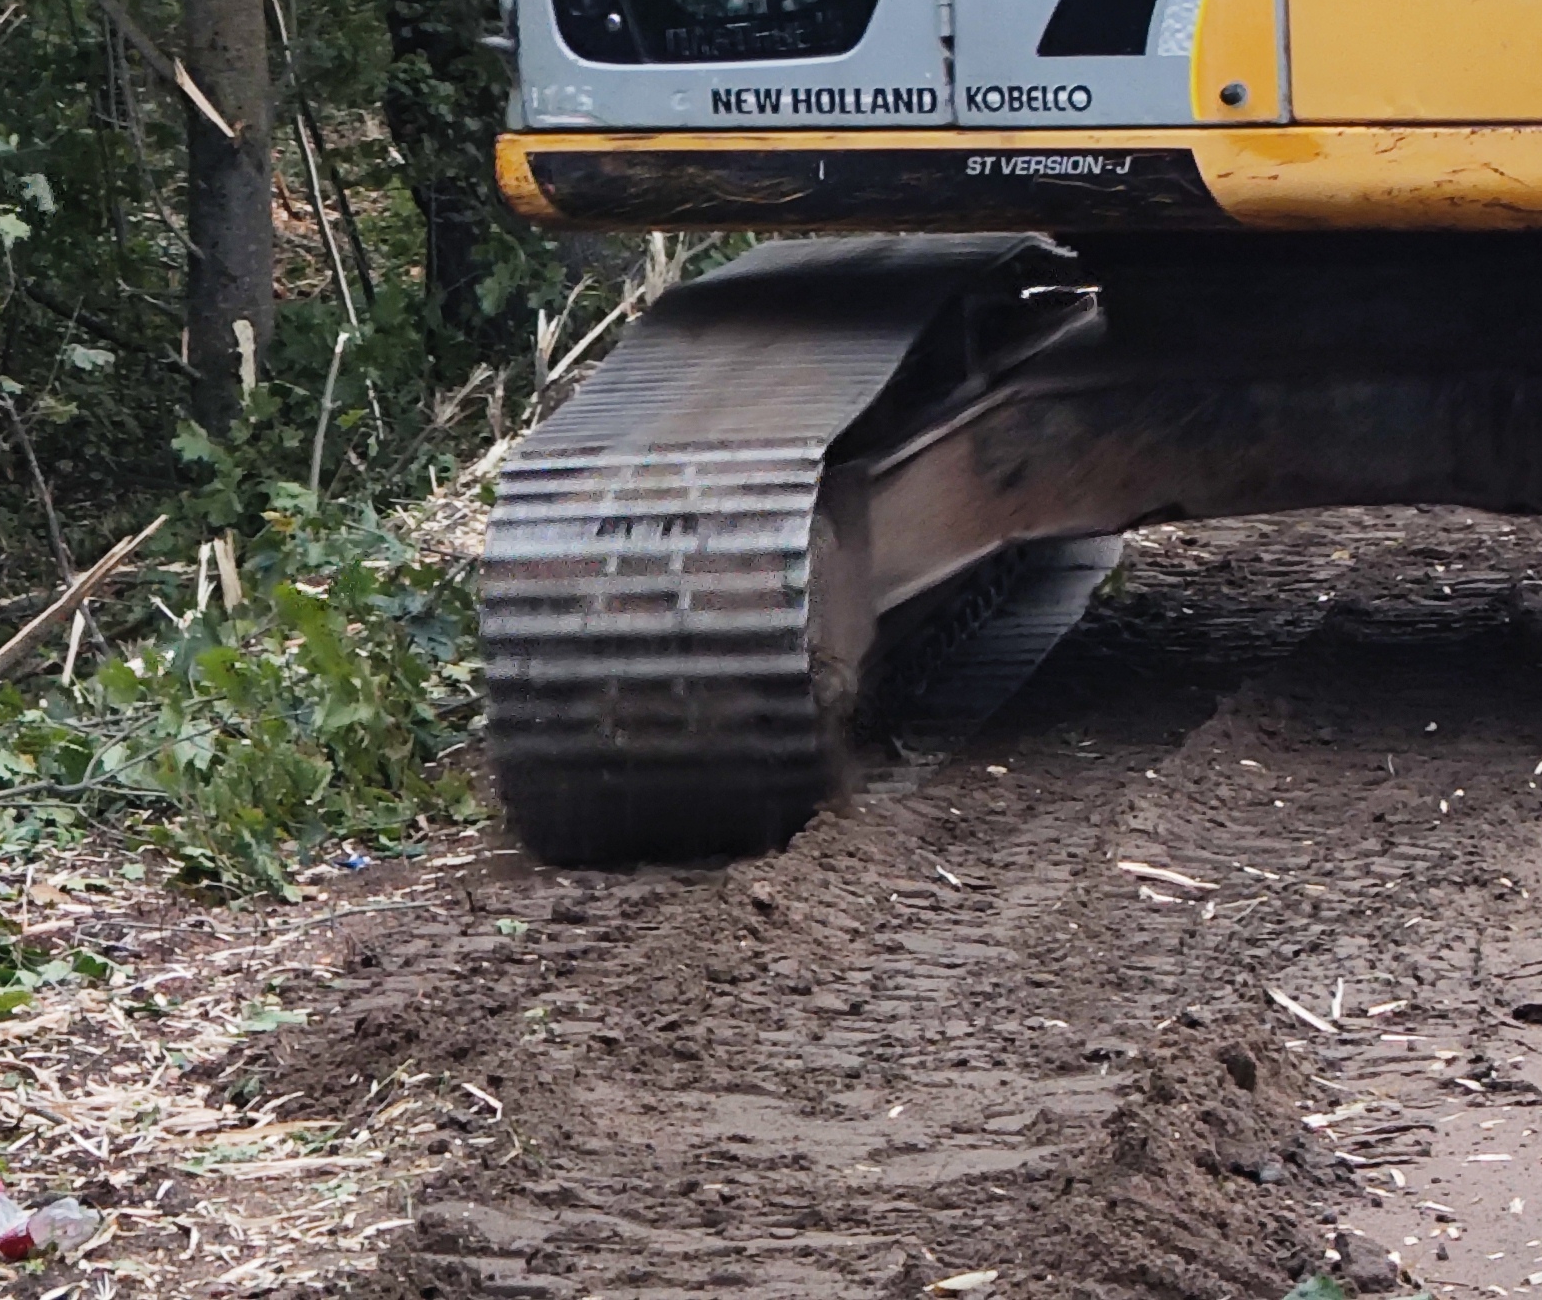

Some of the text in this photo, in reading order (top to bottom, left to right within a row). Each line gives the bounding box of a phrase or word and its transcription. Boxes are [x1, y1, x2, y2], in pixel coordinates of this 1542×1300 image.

[711, 87, 937, 114] NEW HOLLAND
[965, 84, 1092, 112] KOBELCO
[965, 156, 996, 175] ST
